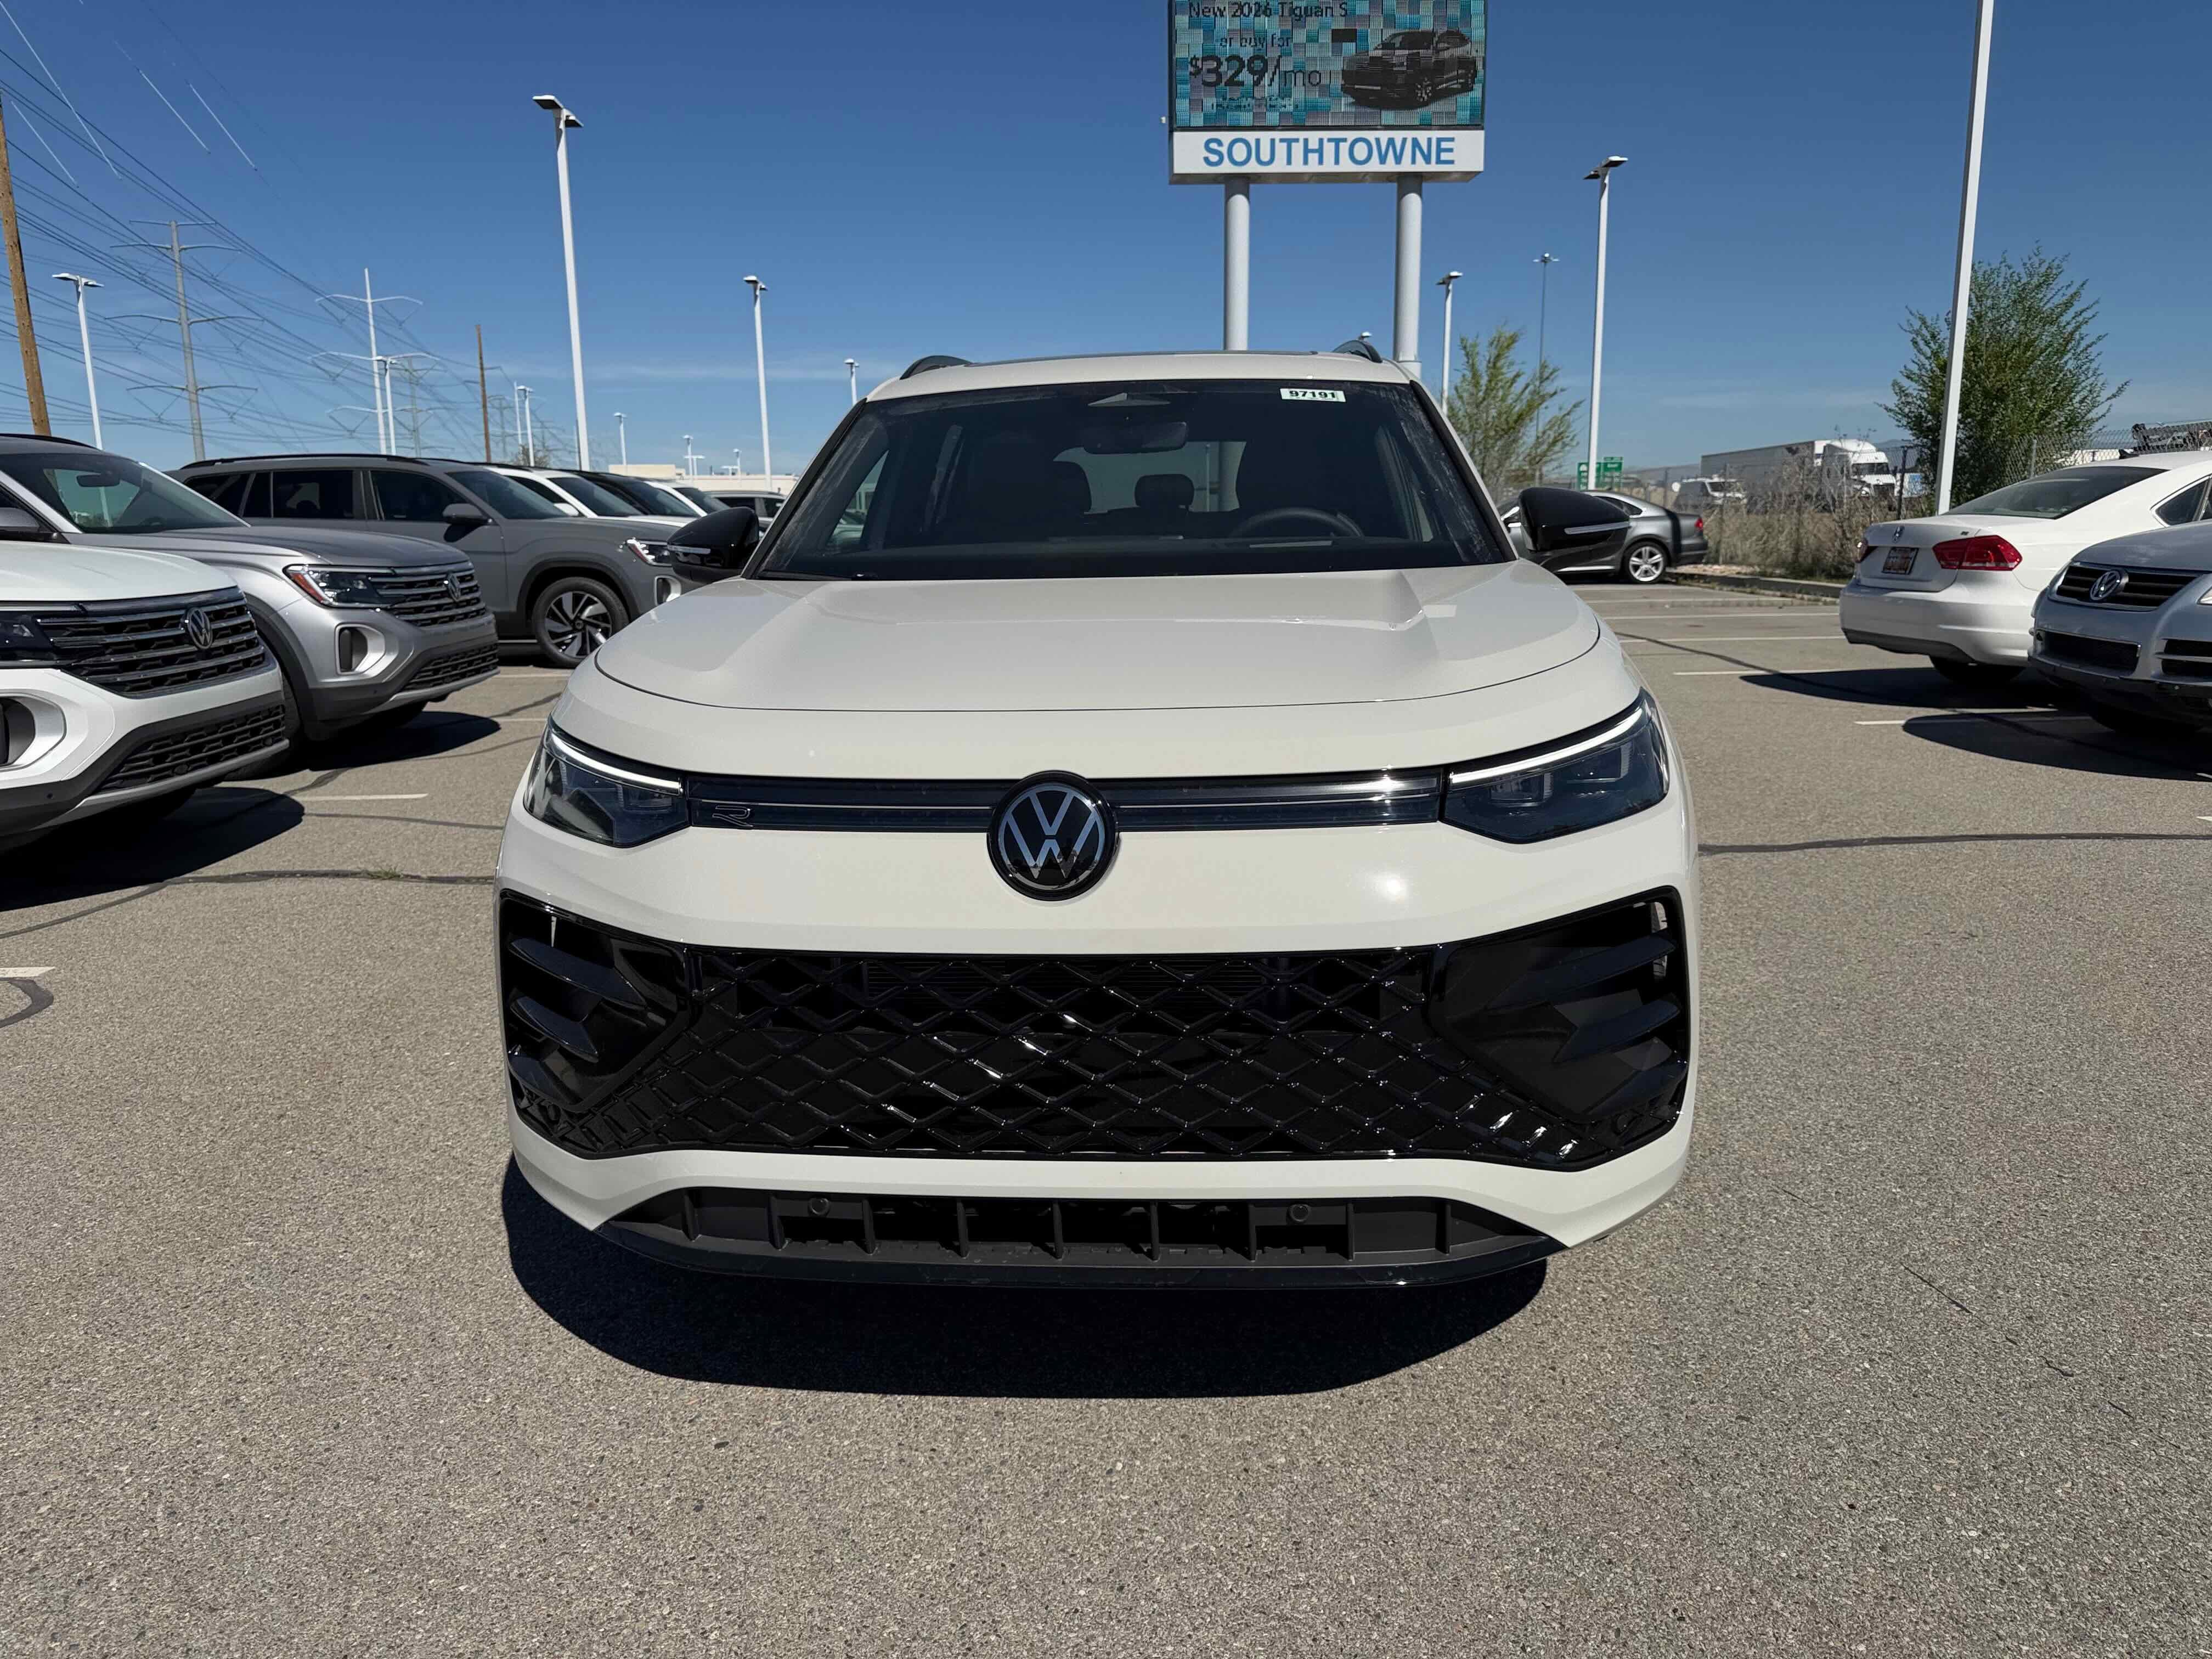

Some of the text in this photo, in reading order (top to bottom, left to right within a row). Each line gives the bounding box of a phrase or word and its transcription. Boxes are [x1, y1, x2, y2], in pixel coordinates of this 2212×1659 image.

[1189, 1, 1347, 21] New 2026 Tiguan S
[1203, 137, 1455, 167] SOUTHTOWNE
[1289, 390, 1335, 398] 97191
